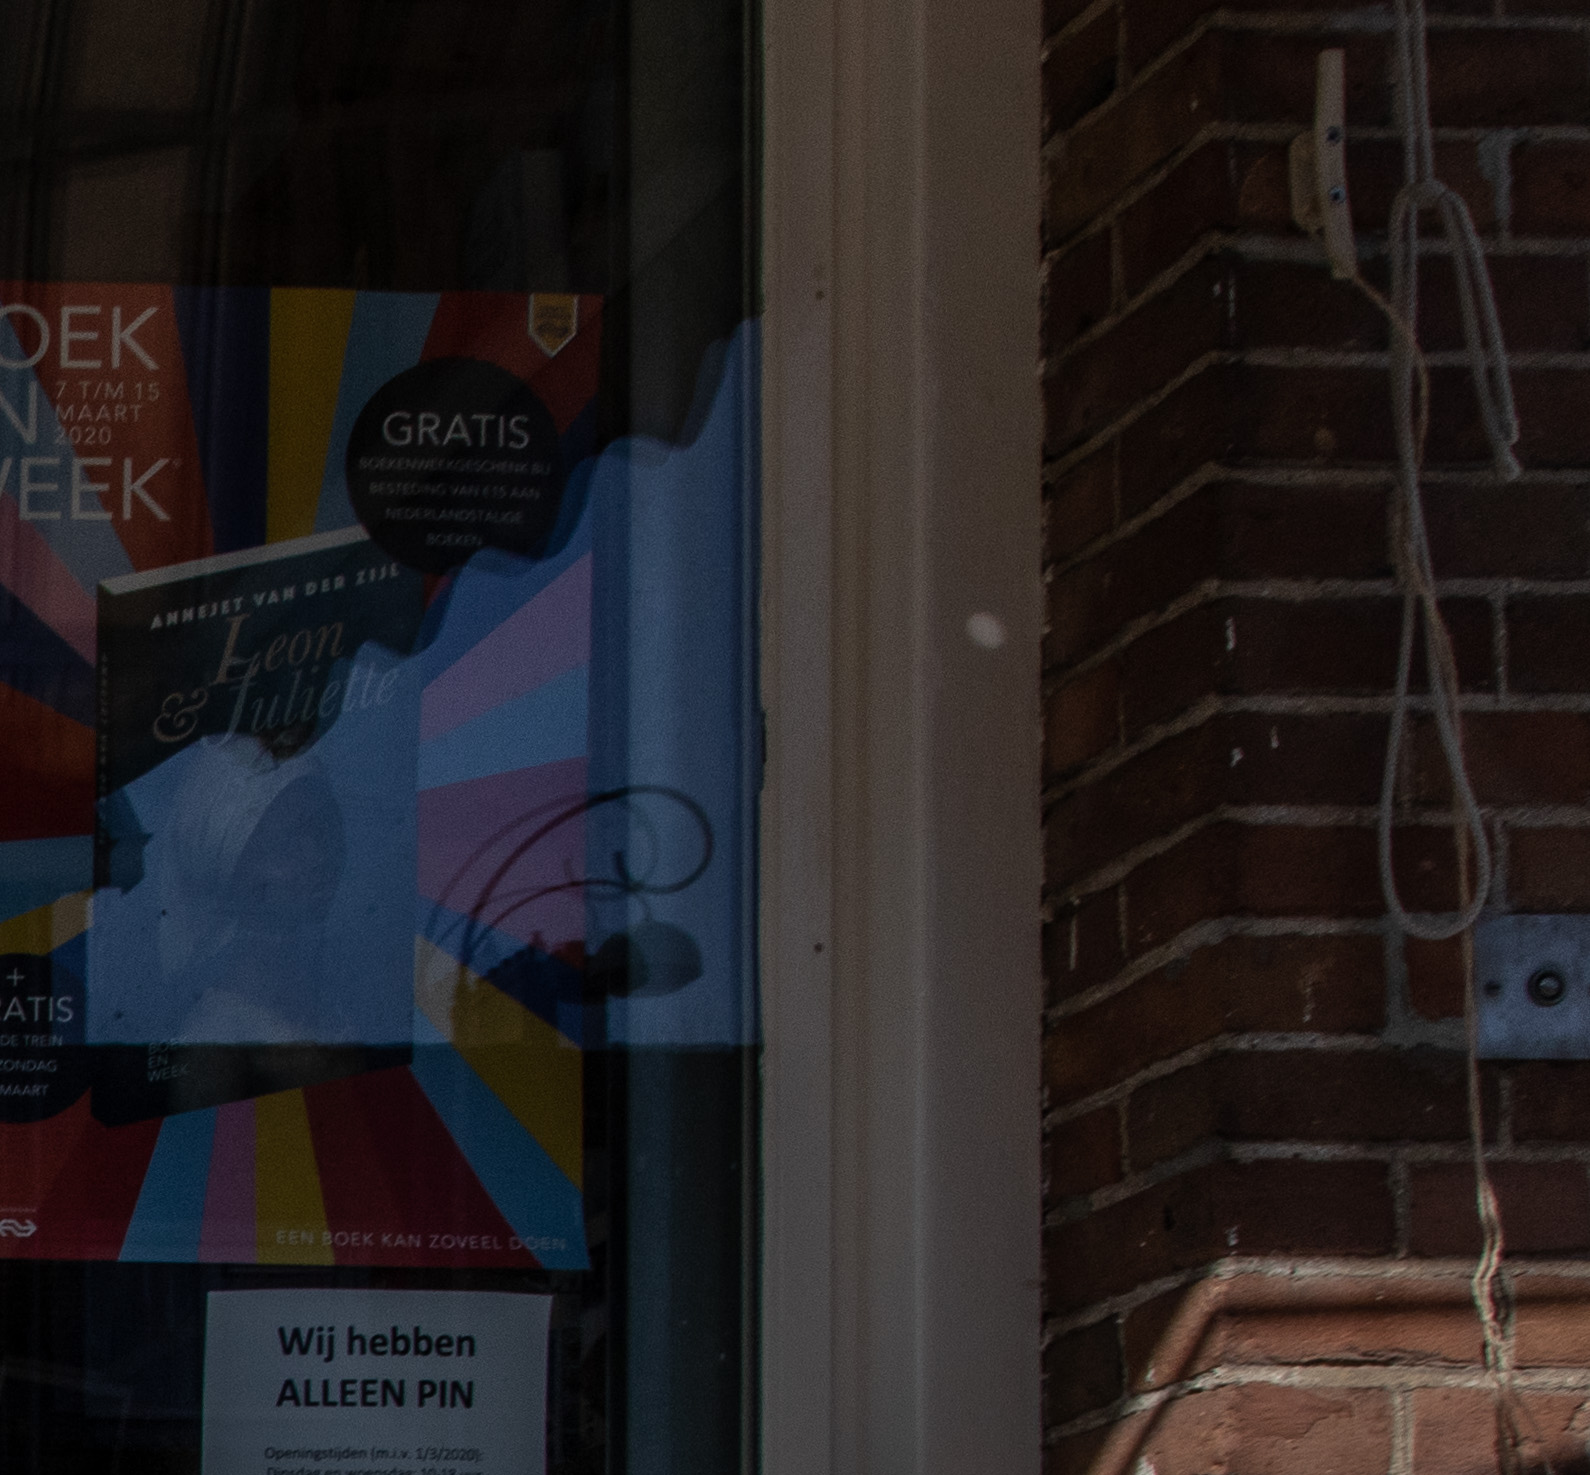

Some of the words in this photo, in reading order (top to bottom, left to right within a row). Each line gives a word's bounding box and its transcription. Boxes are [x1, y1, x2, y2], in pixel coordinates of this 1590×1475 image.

[54, 382, 67, 400] 7
[77, 382, 125, 401] T/M
[135, 382, 161, 402] 15
[55, 404, 143, 423] MAART
[54, 426, 113, 446] 2020
[382, 410, 531, 450] GRATIS
[252, 584, 298, 607] VAN
[304, 575, 347, 597] DER
[208, 613, 345, 687] Leon
[152, 687, 210, 744] &
[208, 650, 401, 750] Juliette
[275, 1229, 315, 1247] EEN
[320, 1230, 375, 1248] BOEK
[381, 1232, 422, 1249] KAN
[428, 1233, 504, 1251] ZOVEEL
[276, 1325, 336, 1363] Wij
[347, 1326, 476, 1358] hebben
[275, 1378, 406, 1408] ALLEEN
[417, 1380, 476, 1409] PIN
